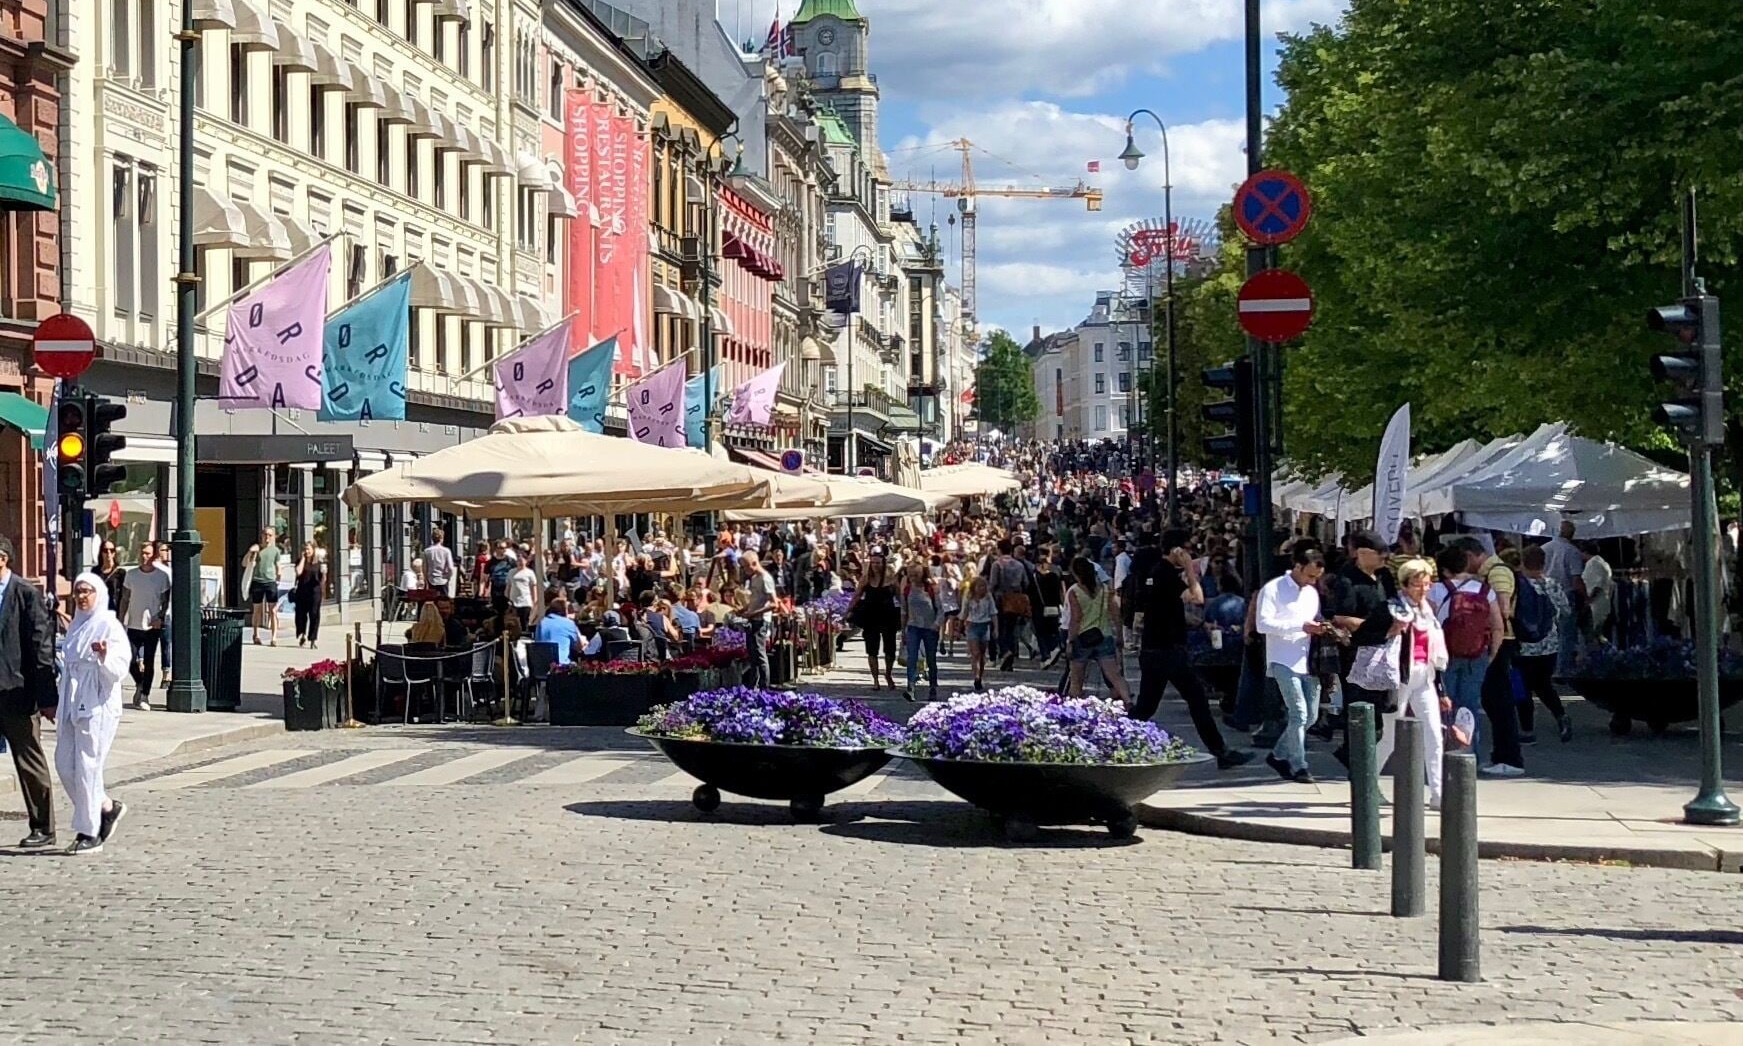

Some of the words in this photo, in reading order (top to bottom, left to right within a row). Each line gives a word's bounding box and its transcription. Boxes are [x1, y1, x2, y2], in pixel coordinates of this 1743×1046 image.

[571, 104, 590, 216] SHOPPING
[595, 118, 614, 265] RESTAURANTS
[307, 441, 343, 455] PALEET
